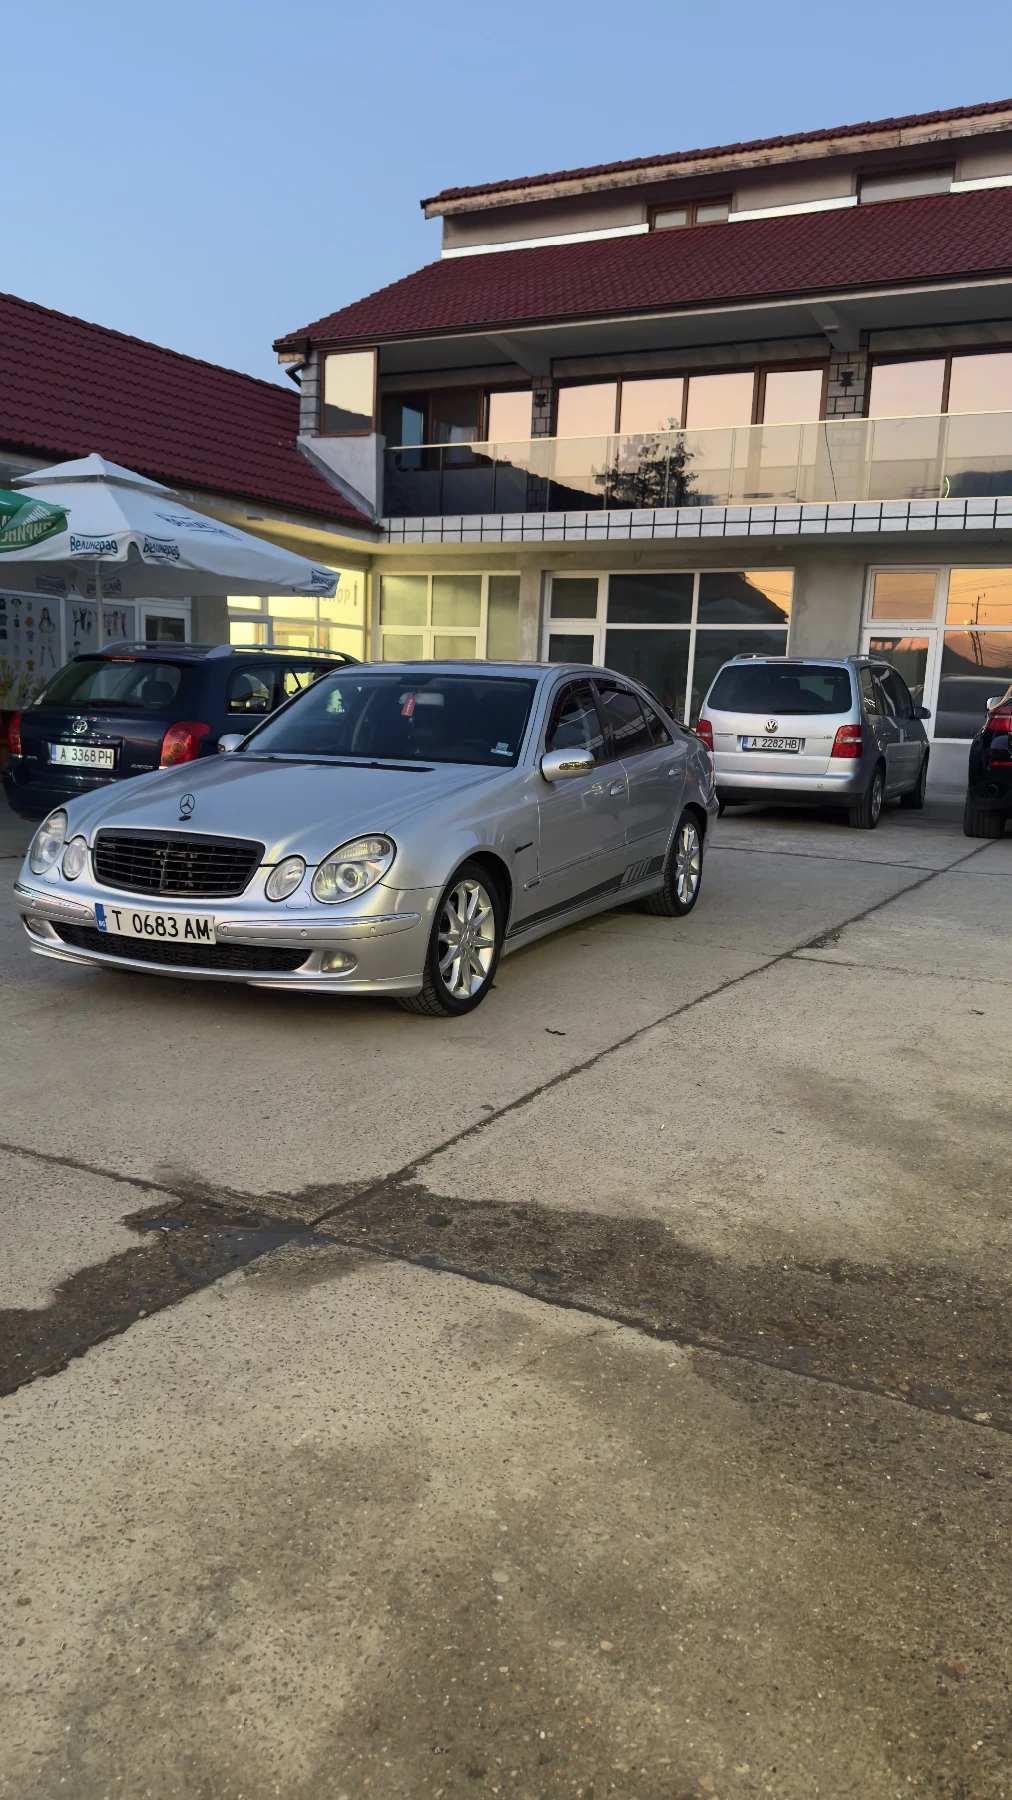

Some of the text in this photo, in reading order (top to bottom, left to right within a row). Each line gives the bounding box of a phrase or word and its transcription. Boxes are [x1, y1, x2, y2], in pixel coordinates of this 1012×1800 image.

[70, 536, 118, 554] Велинград
[143, 537, 180, 560] Велинград
[752, 738, 797, 749] A 2282 HB
[61, 747, 112, 764] A 3368 PH
[112, 910, 210, 940] T 0683 AM
